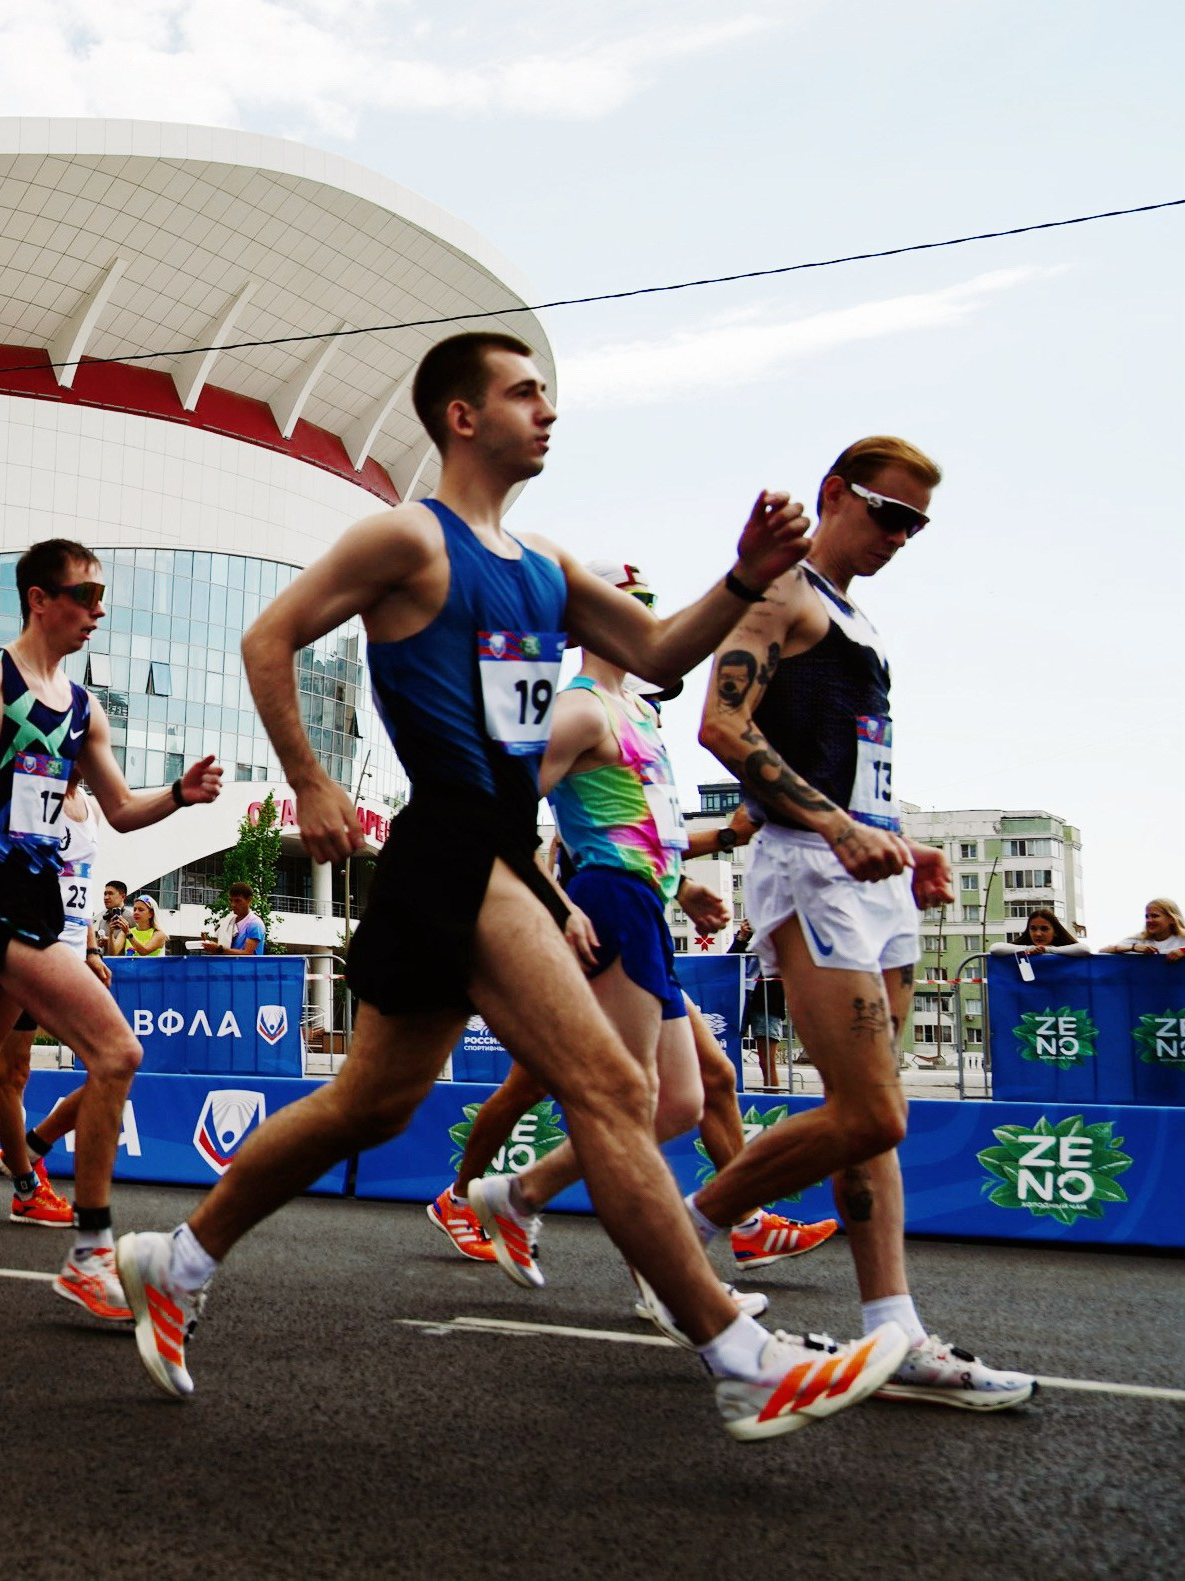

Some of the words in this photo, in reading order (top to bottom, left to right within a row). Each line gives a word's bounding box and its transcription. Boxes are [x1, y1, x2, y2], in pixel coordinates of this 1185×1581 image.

[515, 679, 553, 725] 19
[873, 761, 891, 802] 13
[41, 790, 65, 824] 17
[66, 884, 87, 910] 23
[134, 1008, 242, 1038] ВФЛА
[1034, 1016, 1078, 1036] ZE
[1036, 1036, 1080, 1056] NO
[1017, 1135, 1093, 1169] ZE
[1017, 1168, 1094, 1203] NO
